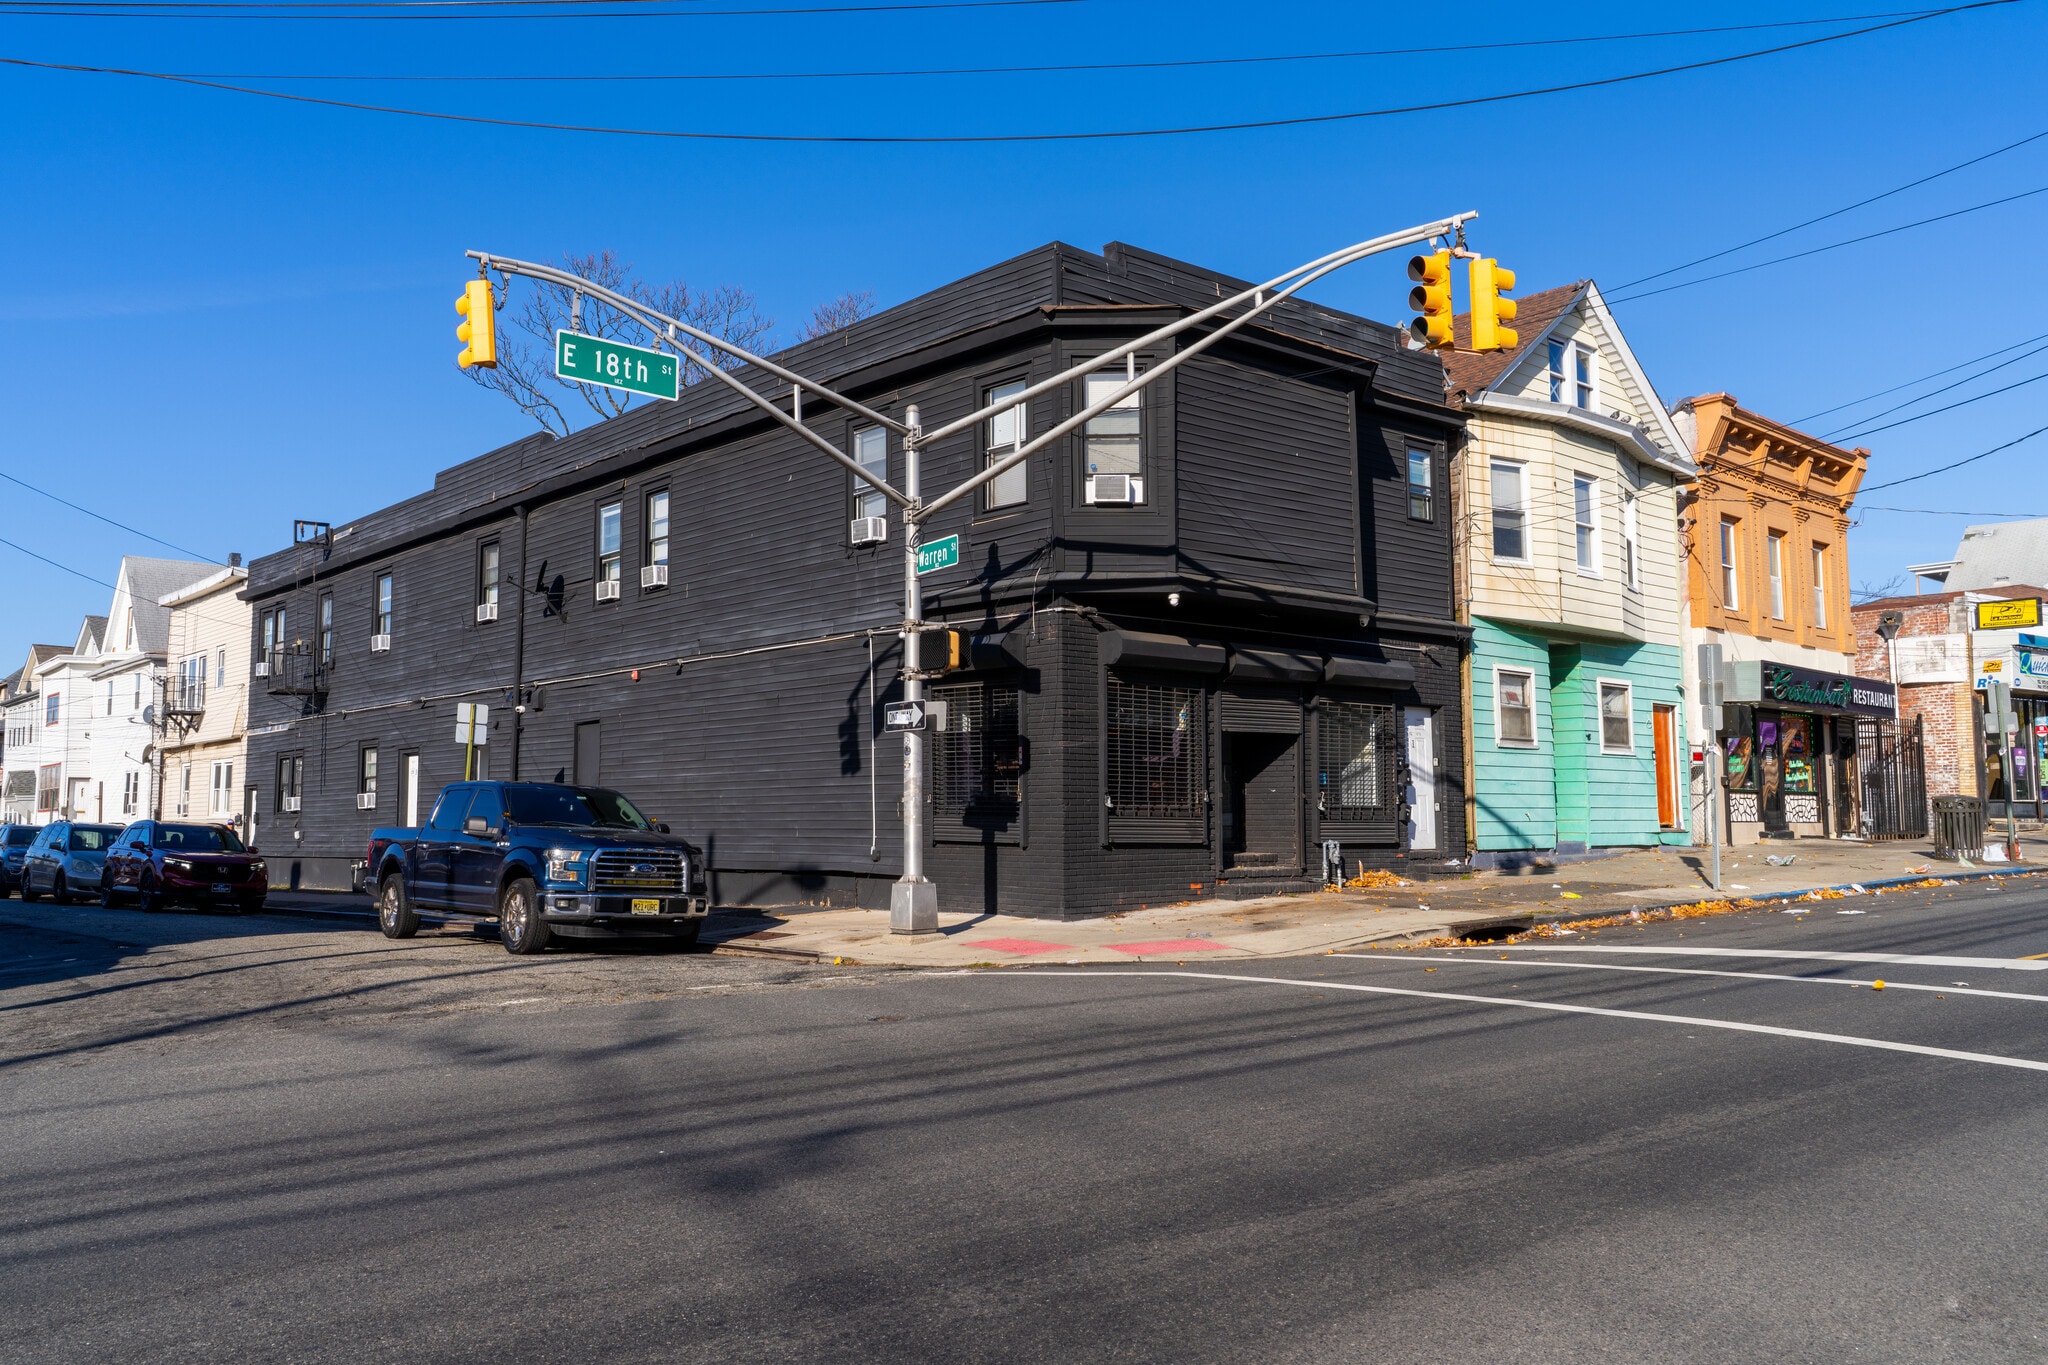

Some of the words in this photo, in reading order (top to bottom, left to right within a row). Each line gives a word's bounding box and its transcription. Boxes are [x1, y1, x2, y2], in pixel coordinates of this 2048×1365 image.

[563, 343, 576, 368] E
[595, 350, 648, 383] 18th
[661, 364, 672, 375] St
[919, 548, 948, 567] Warren
[951, 542, 957, 551] St
[1853, 688, 1897, 709] RESTAURANT
